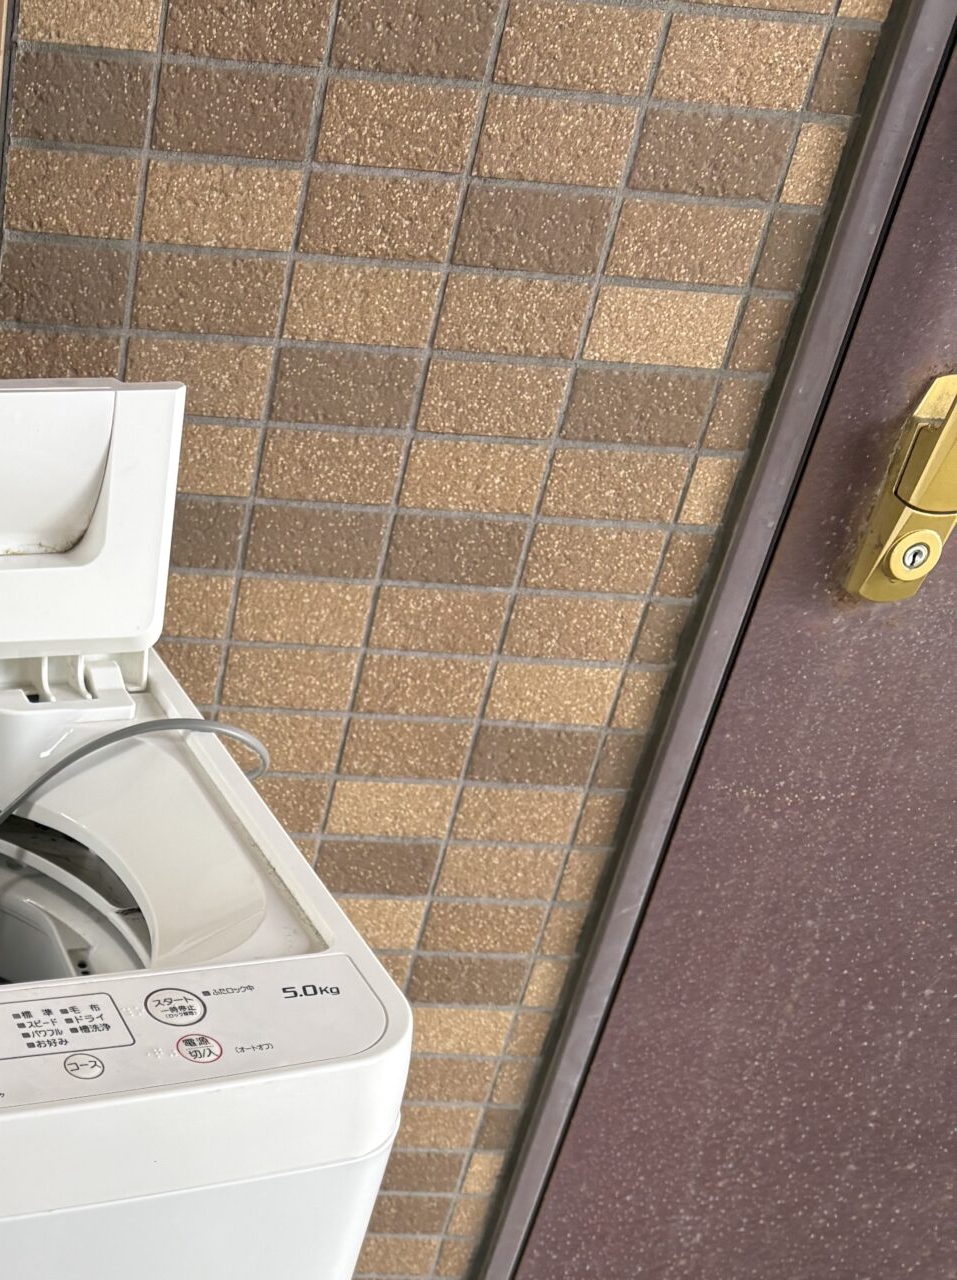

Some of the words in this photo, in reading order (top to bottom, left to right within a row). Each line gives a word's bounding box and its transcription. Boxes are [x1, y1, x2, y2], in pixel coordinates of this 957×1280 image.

[152, 996, 194, 1007] スタート
[26, 1018, 57, 1028] スピード
[75, 1013, 104, 1023] ドライ
[32, 1028, 63, 1038] パワフル
[79, 1023, 111, 1033] 槽洗浄
[36, 1038, 68, 1048] お好み
[182, 1036, 210, 1046] 電源
[188, 1047, 218, 1059] 切/入
[67, 1060, 102, 1072] コース
